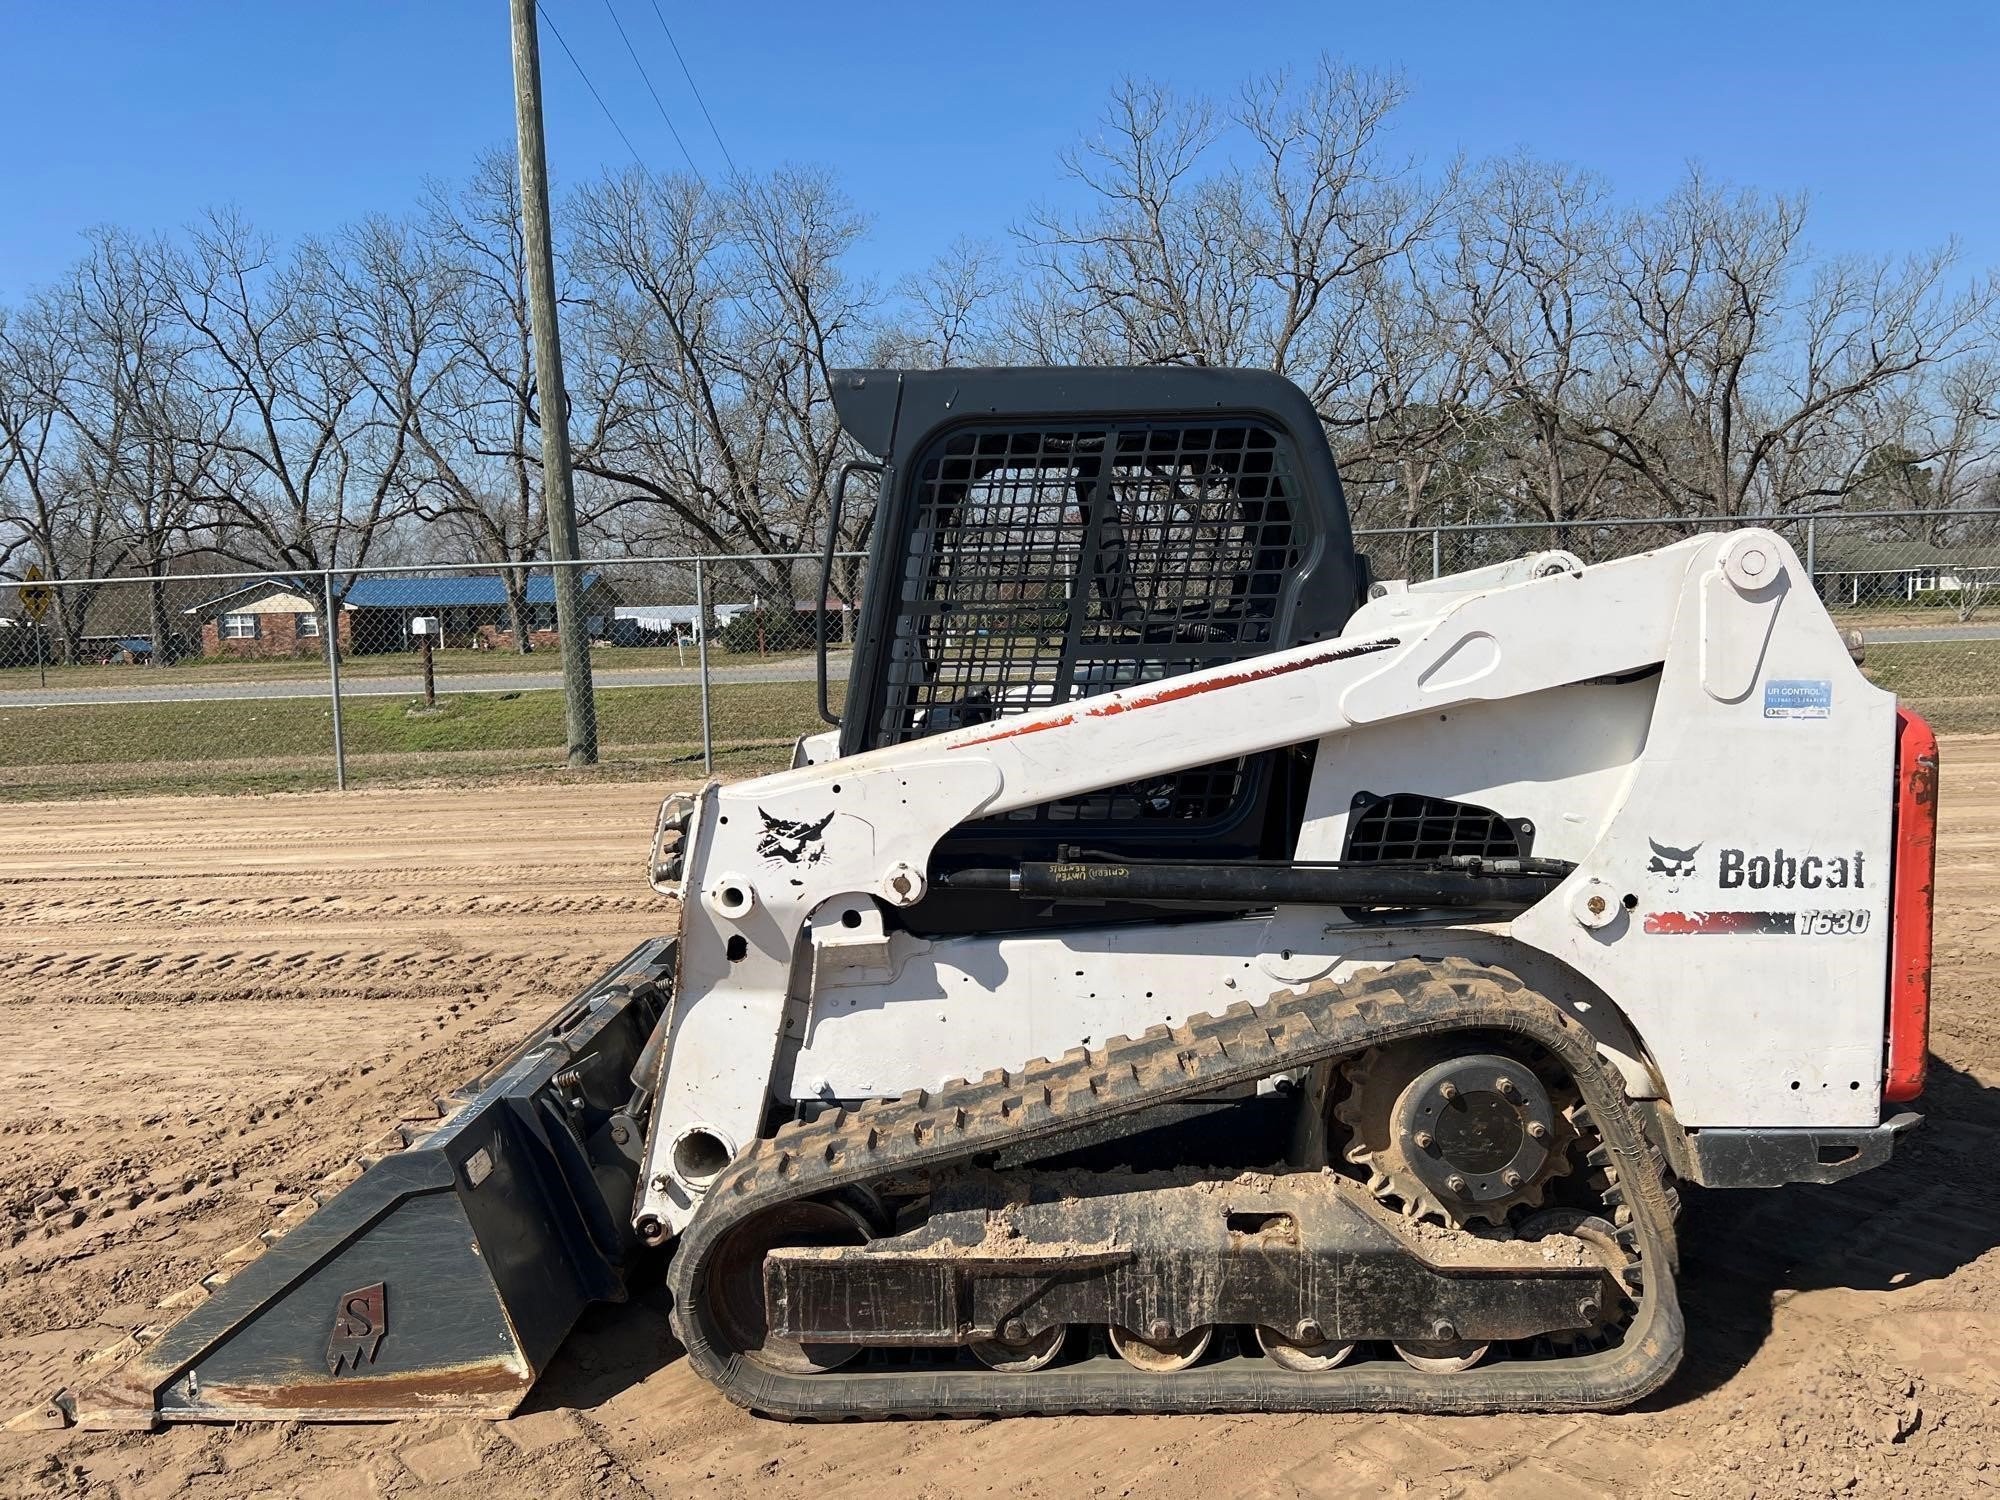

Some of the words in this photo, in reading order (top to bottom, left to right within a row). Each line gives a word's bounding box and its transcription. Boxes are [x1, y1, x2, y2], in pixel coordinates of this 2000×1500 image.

[1781, 688, 1821, 696] CONTROL
[1718, 848, 1865, 889] Bobcat
[1800, 909, 1871, 935] T630
